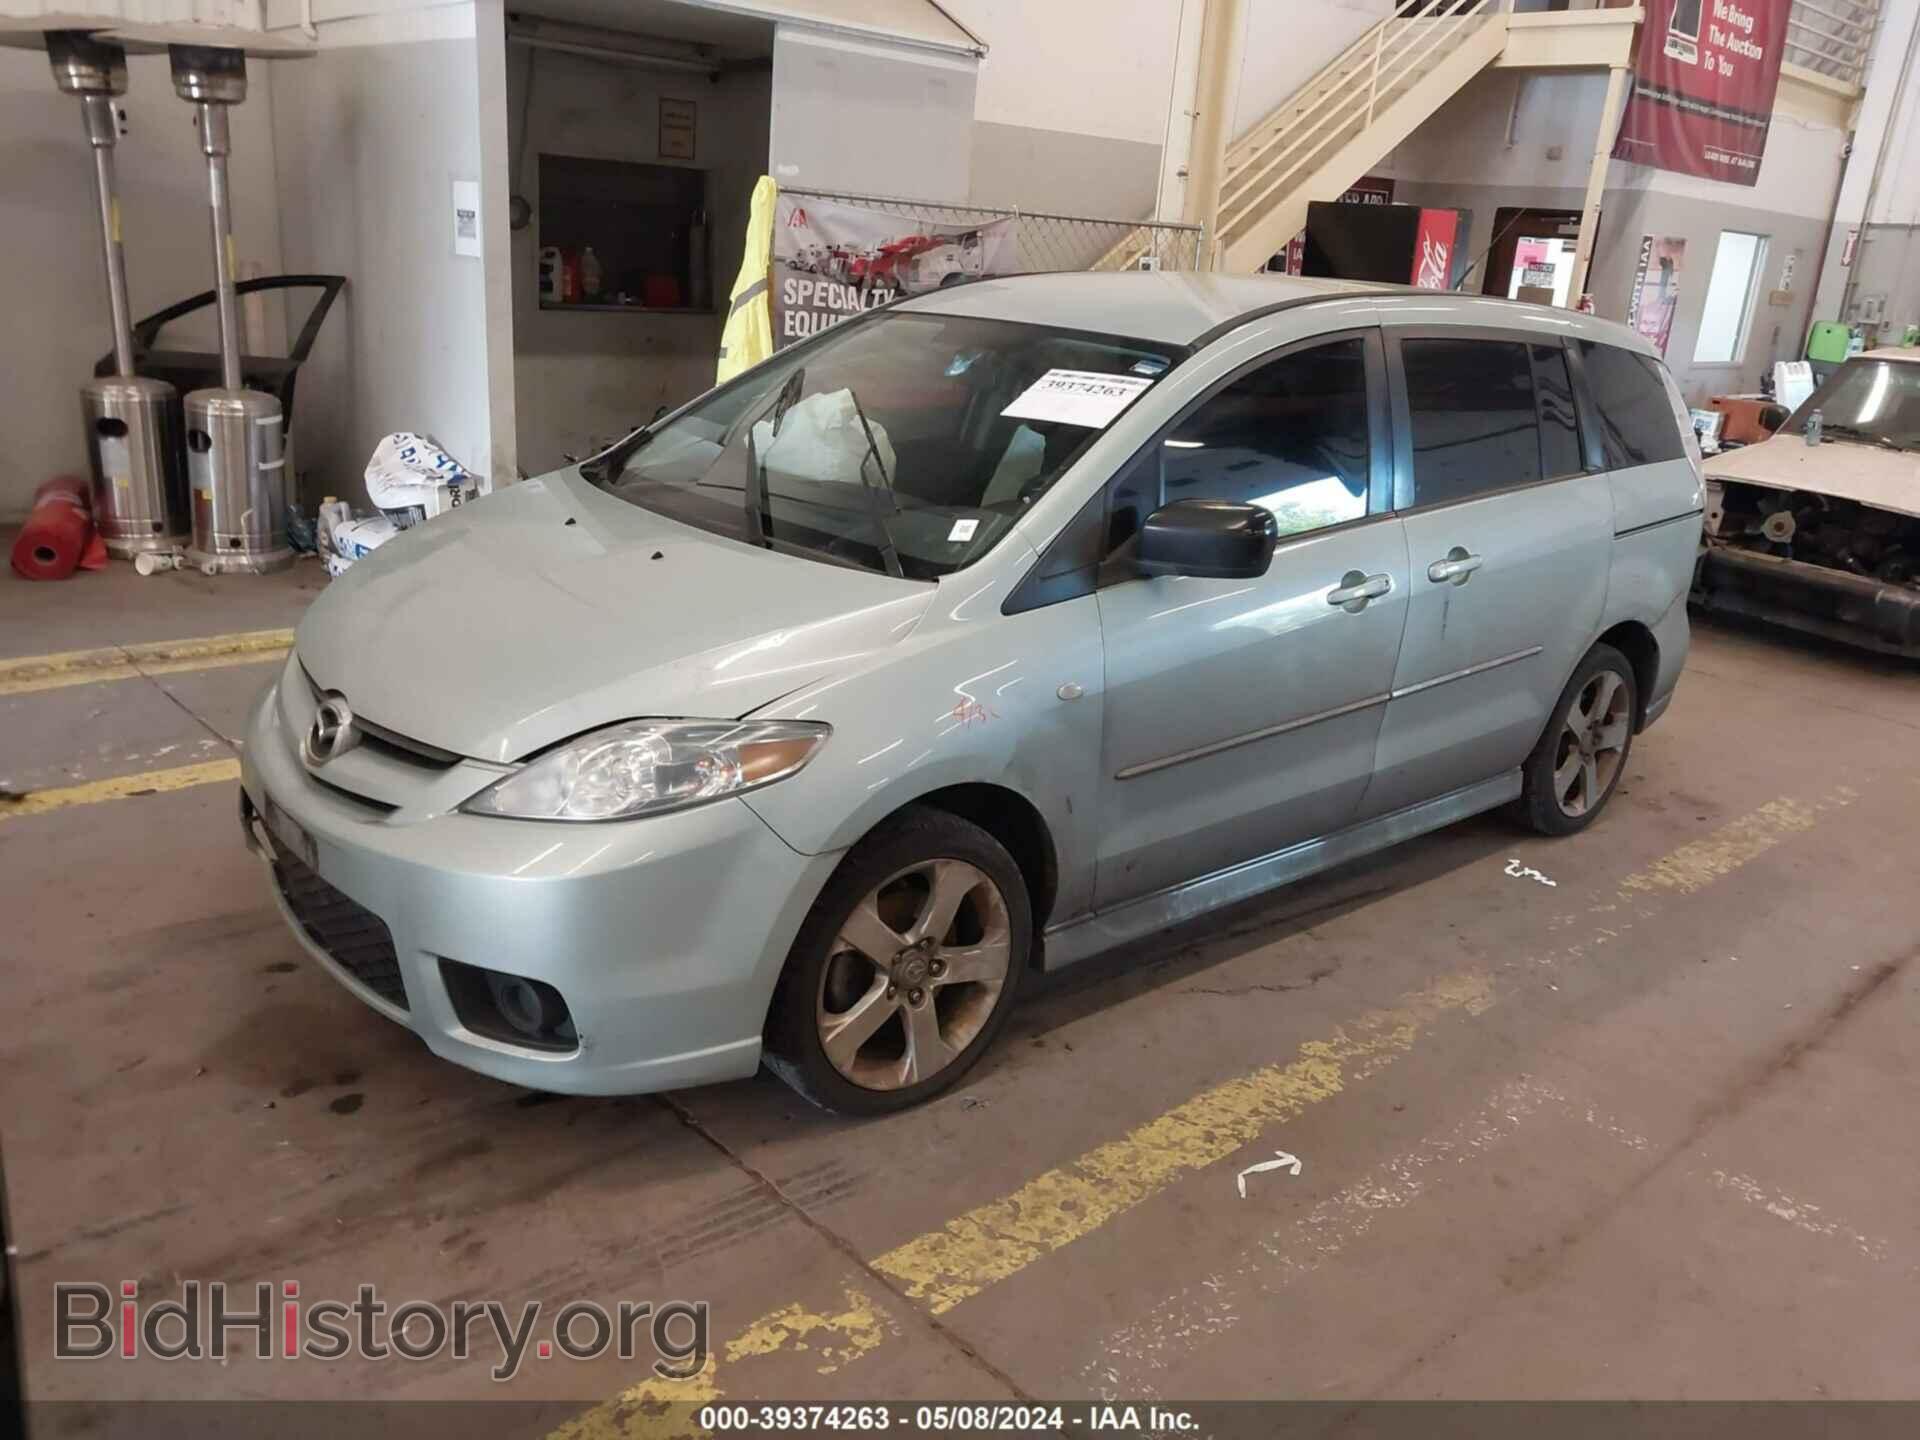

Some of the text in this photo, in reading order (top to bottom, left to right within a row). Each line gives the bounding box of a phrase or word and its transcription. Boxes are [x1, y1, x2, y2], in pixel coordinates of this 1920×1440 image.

[1713, 0, 1754, 34] We Bring
[1709, 24, 1763, 60] The Auction
[1704, 50, 1735, 77] To You
[1639, 240, 1652, 267] IAA
[783, 277, 895, 312] SPECIALTY
